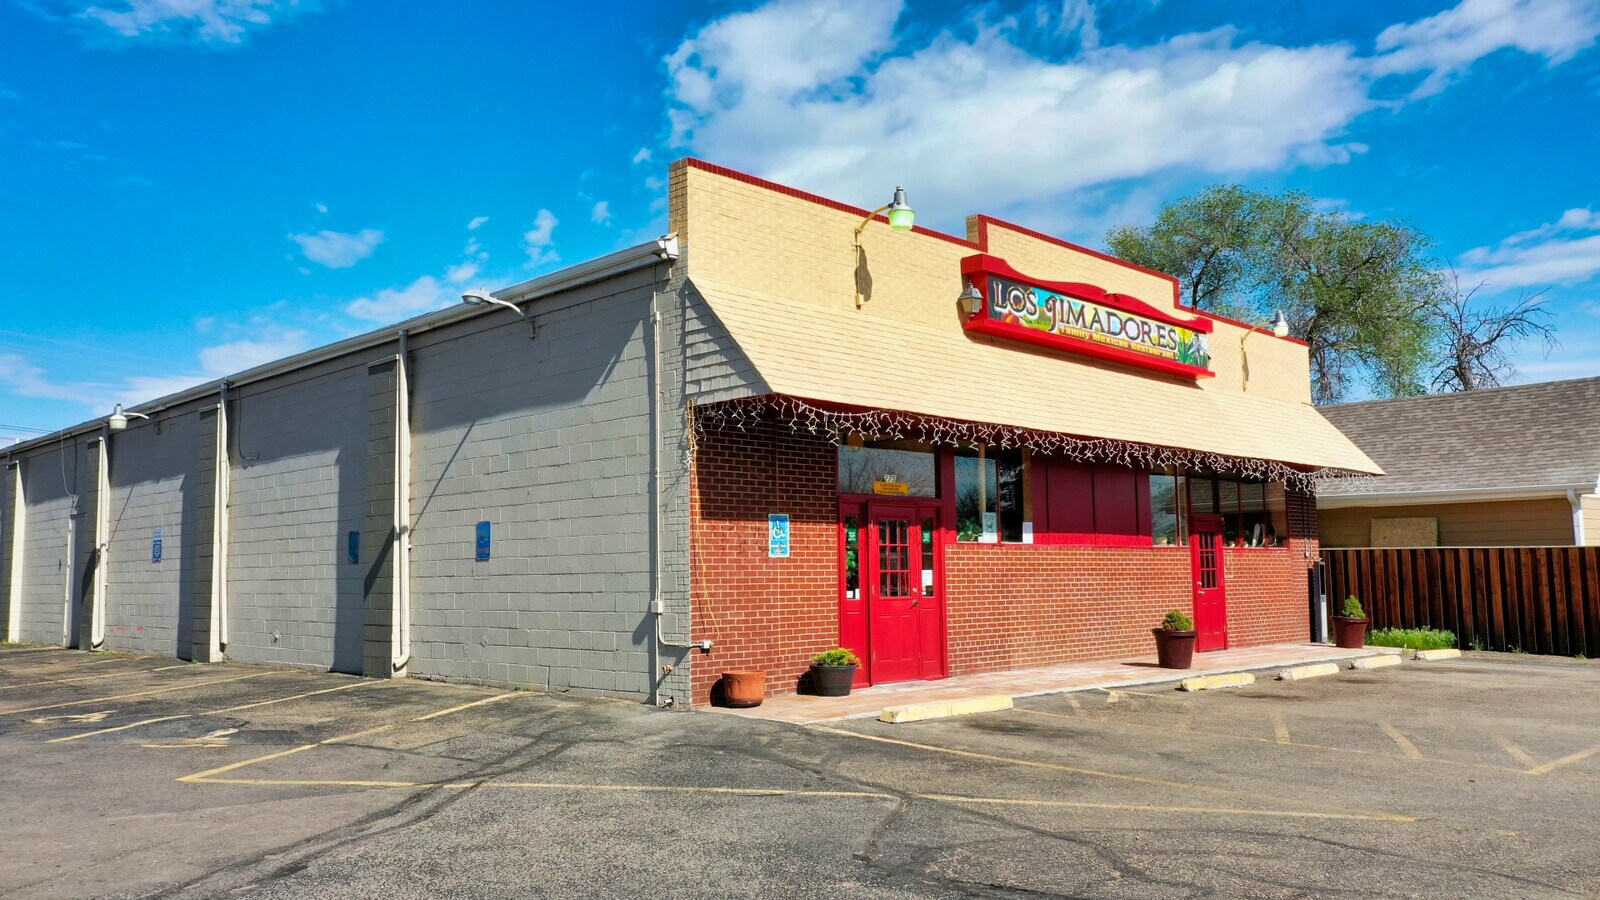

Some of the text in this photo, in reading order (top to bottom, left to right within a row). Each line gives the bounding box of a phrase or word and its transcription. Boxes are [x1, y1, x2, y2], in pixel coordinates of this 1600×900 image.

[993, 281, 1177, 350] LOS JIMADORES
[1060, 326, 1176, 360] Family Mexican Restaurant
